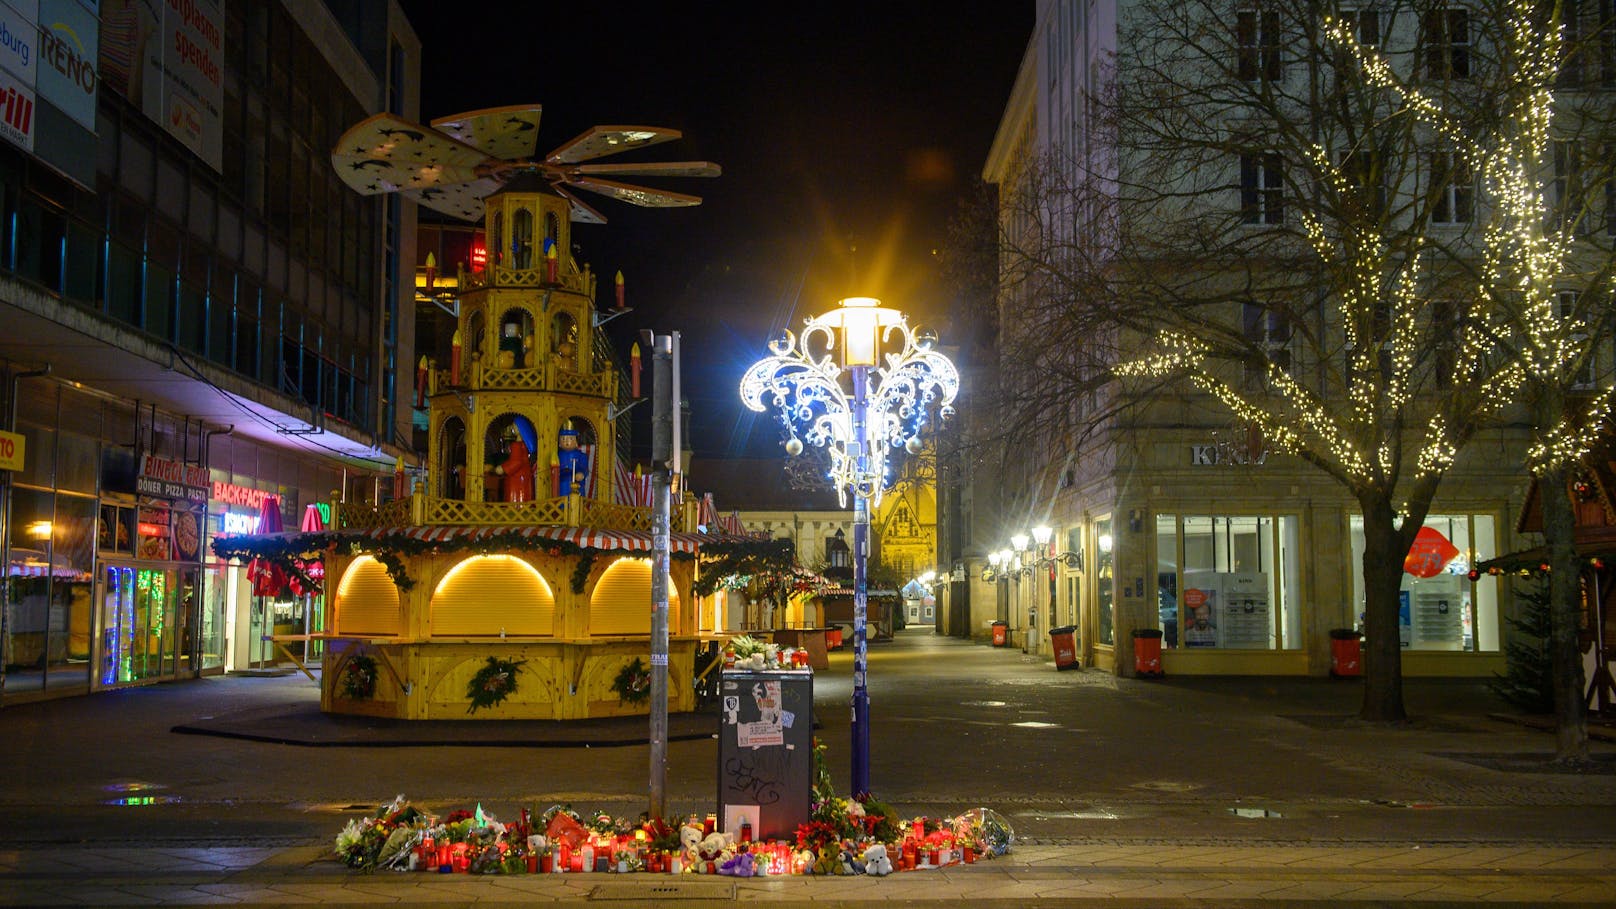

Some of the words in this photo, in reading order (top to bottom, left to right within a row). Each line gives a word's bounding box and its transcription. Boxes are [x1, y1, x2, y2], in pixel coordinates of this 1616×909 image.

[40, 24, 95, 95] RENO
[175, 29, 219, 88] spenden
[165, 484, 184, 497] PIZZA
[187, 489, 206, 502] PASTA
